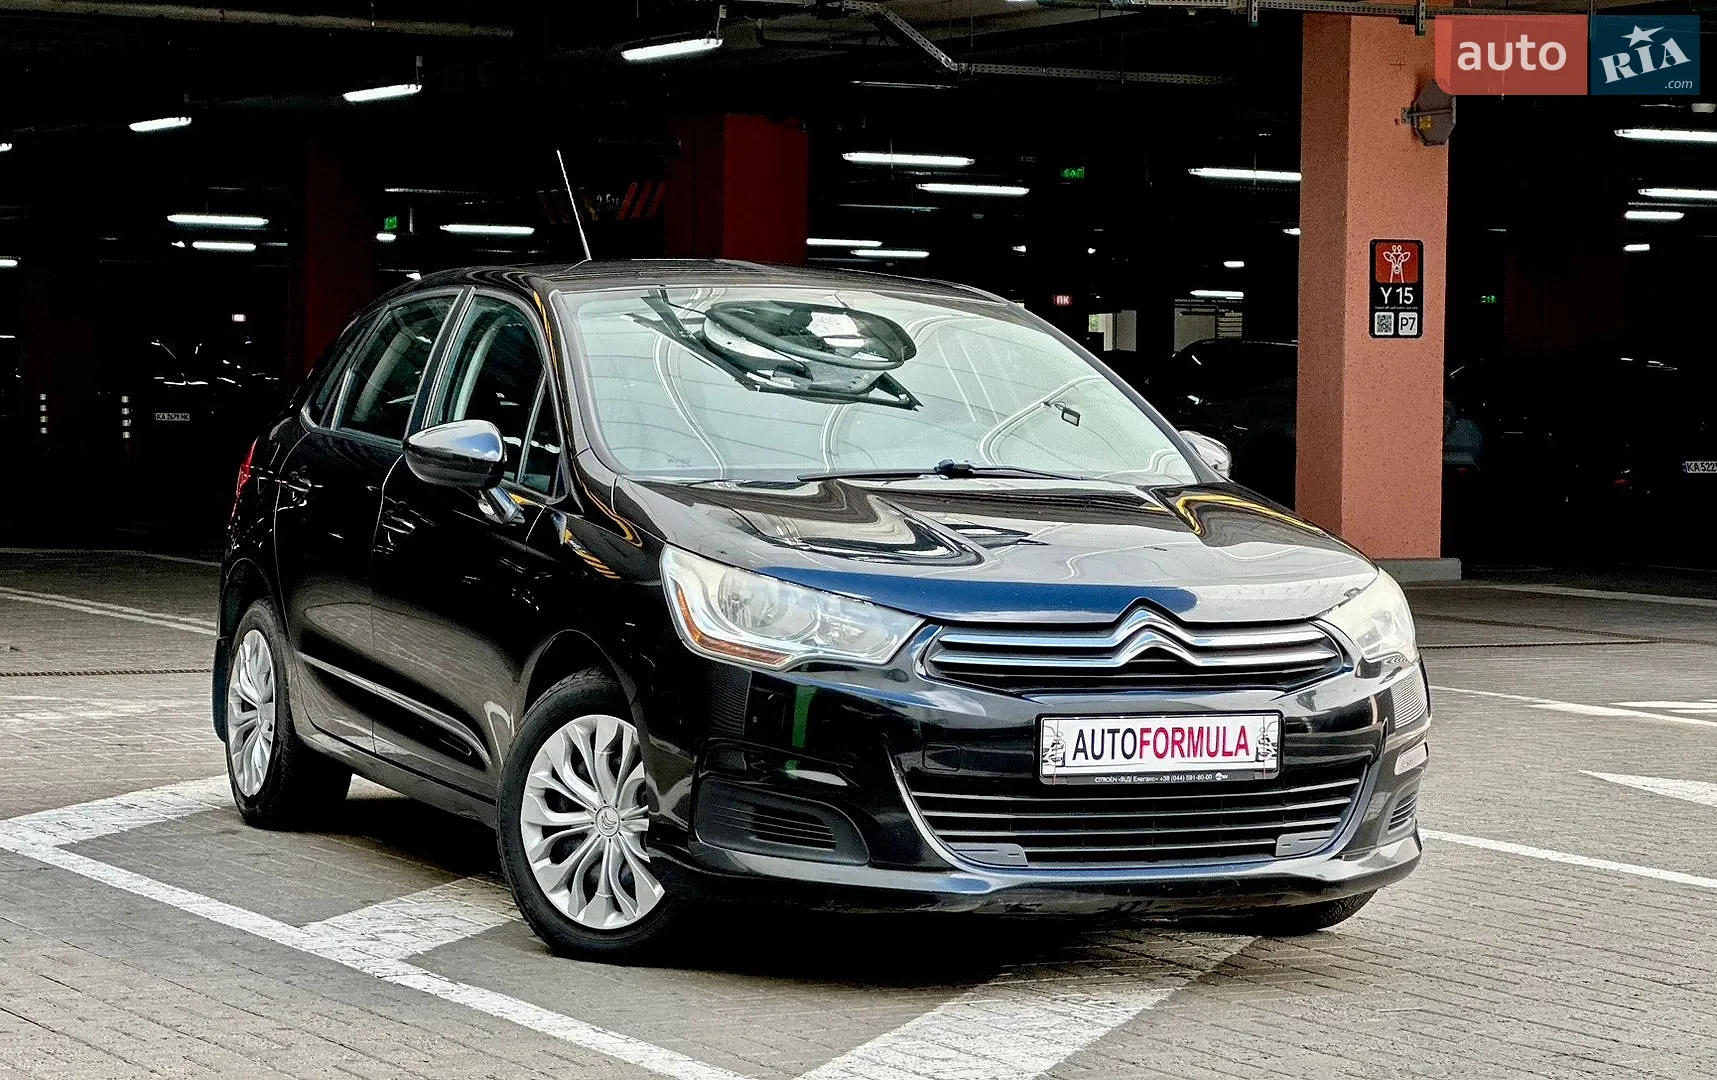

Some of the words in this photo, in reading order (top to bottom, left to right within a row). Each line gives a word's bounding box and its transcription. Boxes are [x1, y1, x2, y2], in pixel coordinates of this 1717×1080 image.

[1380, 286, 1393, 305] Y
[1395, 286, 1414, 305] 15
[1400, 316, 1416, 331] P7
[1072, 725, 1250, 761] AUTOFORMULA
